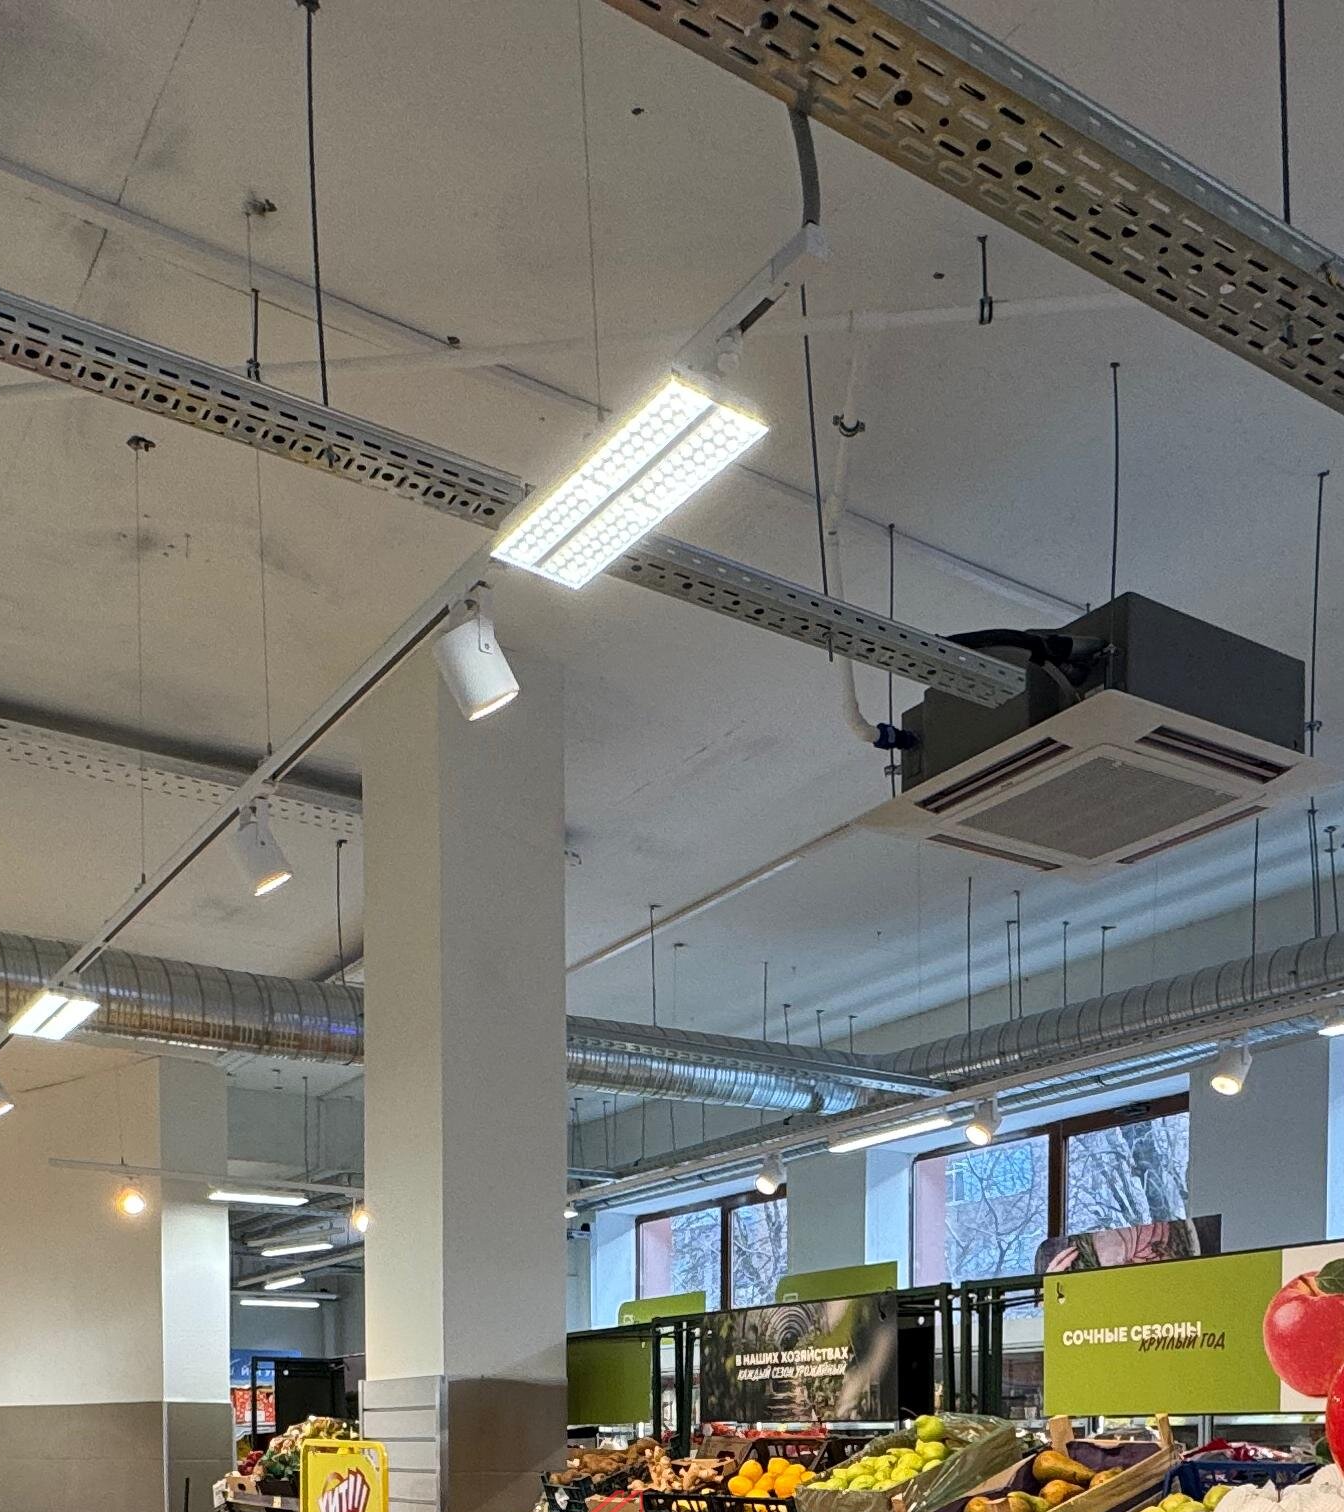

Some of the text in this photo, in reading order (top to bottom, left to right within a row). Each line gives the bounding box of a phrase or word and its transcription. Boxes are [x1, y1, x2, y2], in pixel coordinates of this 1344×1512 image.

[1063, 1321, 1202, 1346] СОЧНЫЕ СЕЗОНЫ
[1138, 1332, 1225, 1352] КРУГЛЫЙ ГОД
[743, 1351, 779, 1365] НАШИХ
[781, 1346, 848, 1364] ХОЗЯЙСТВАХ
